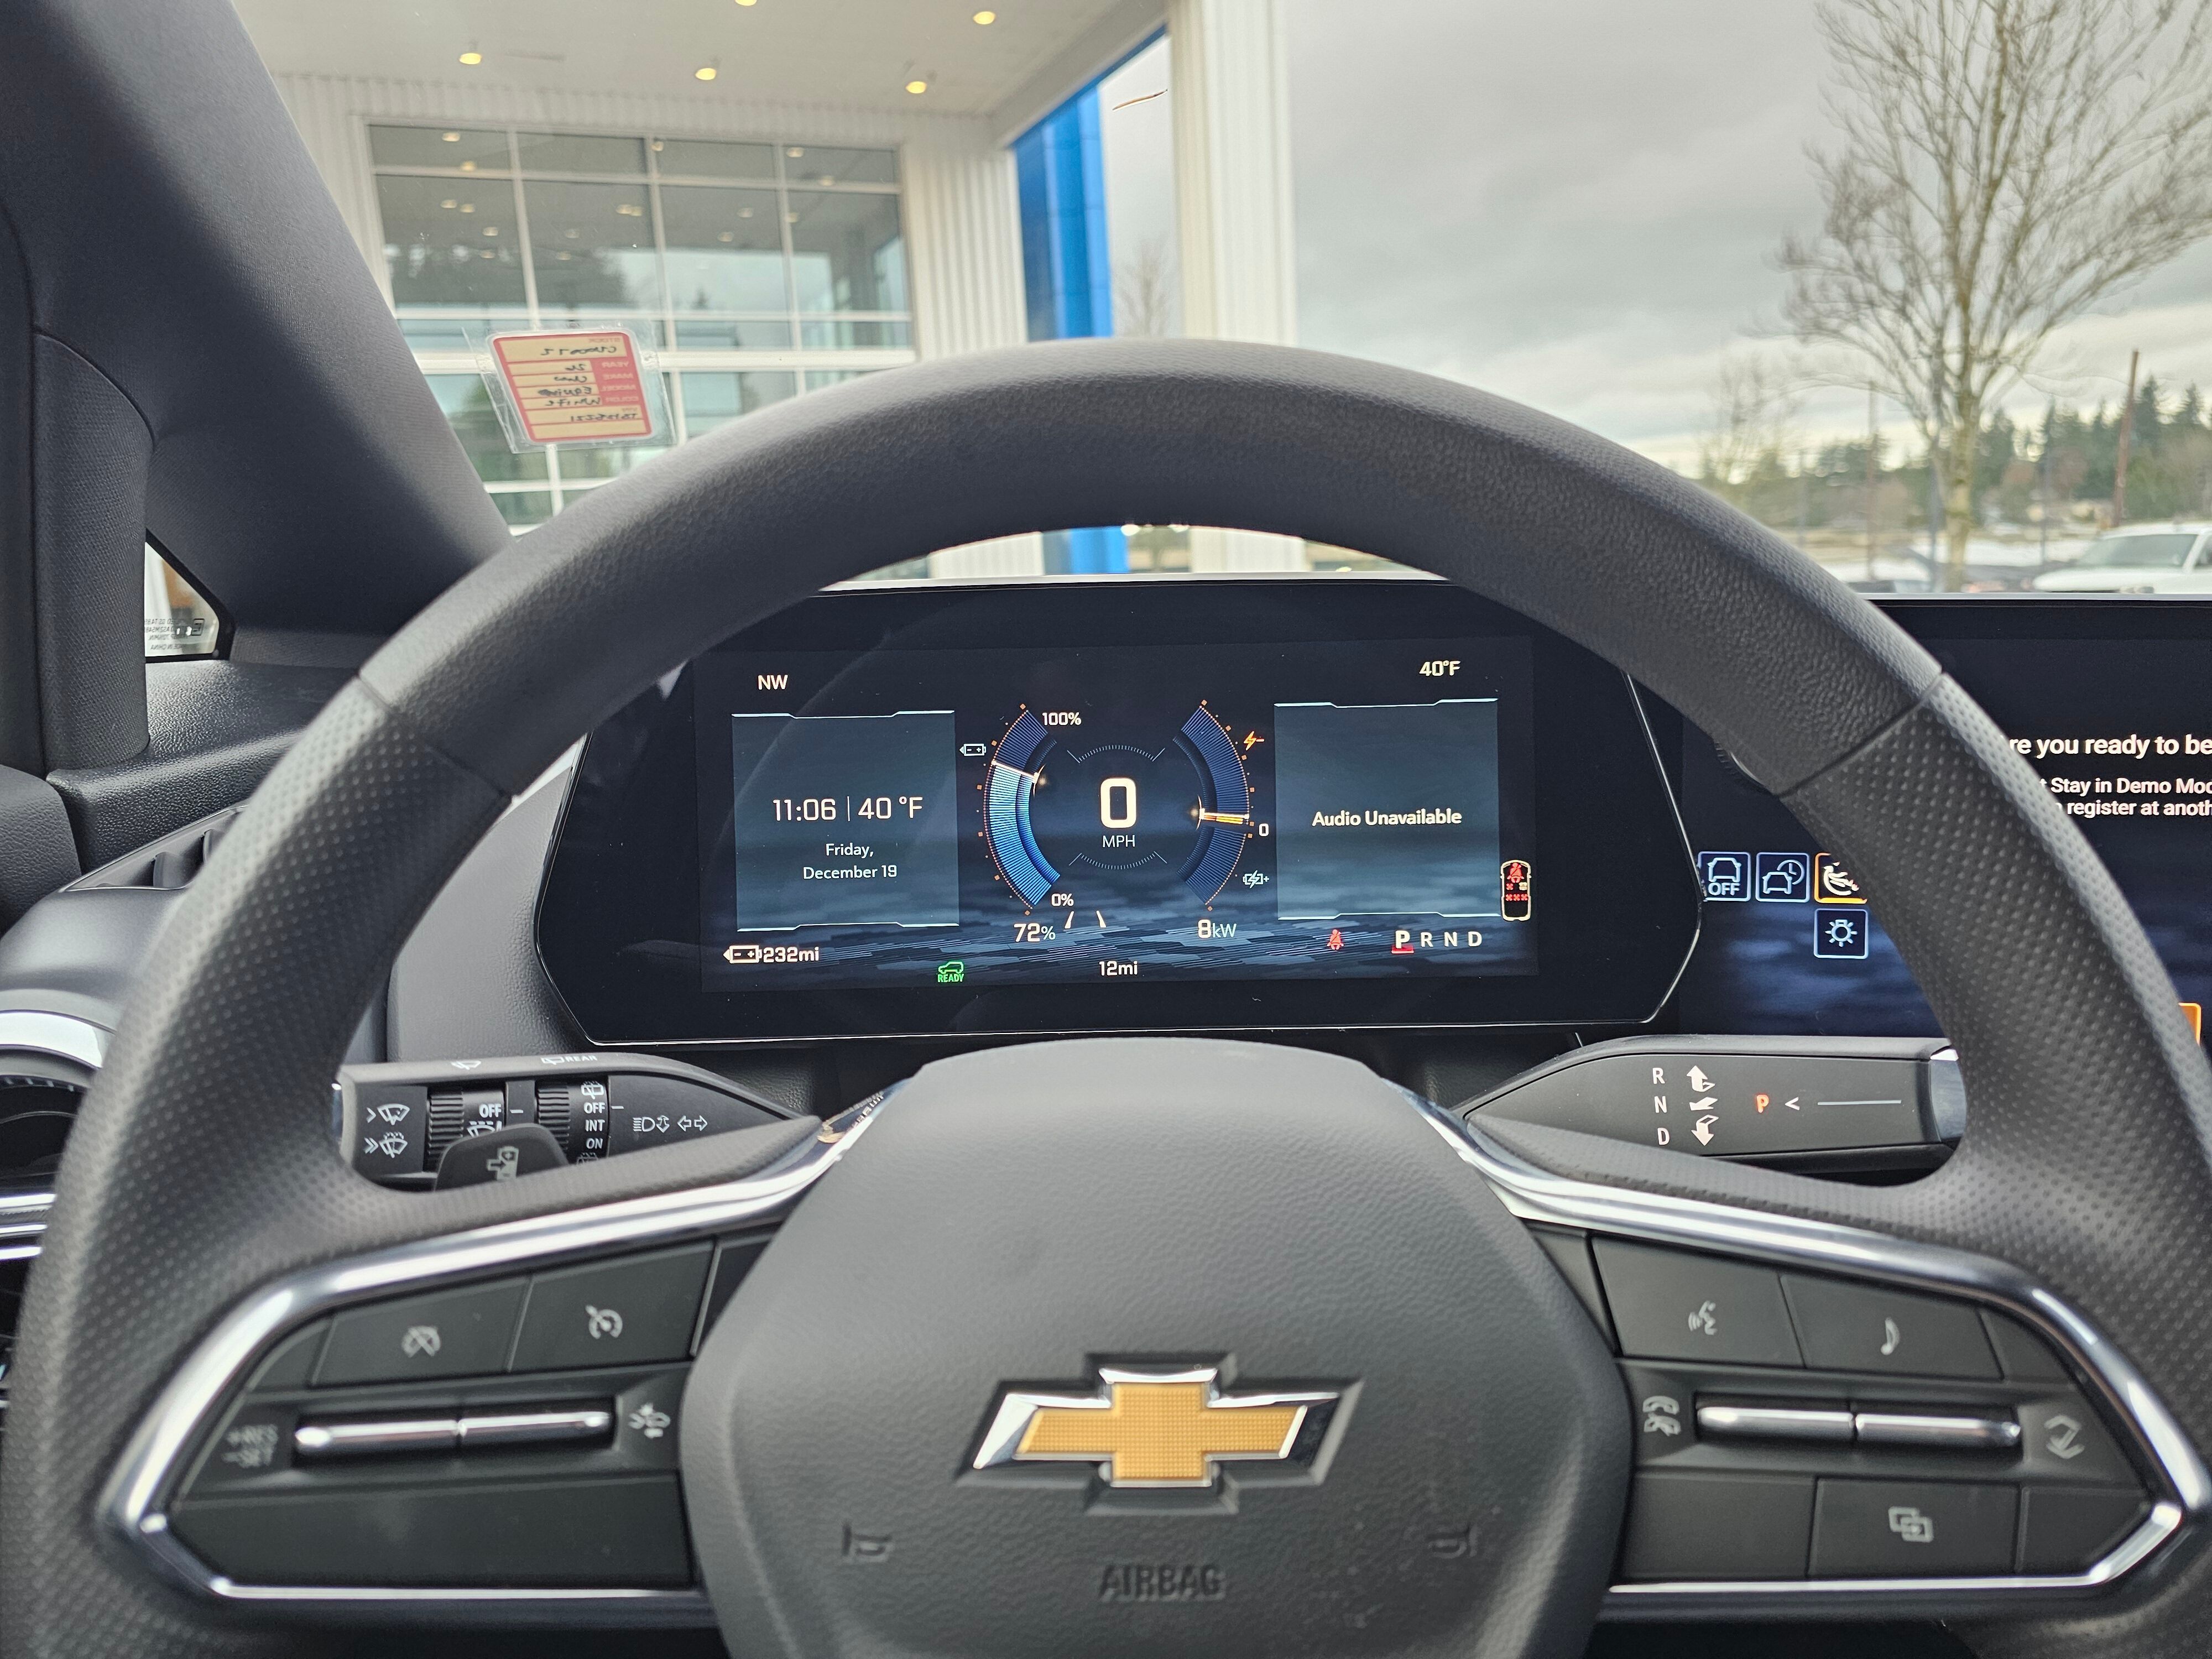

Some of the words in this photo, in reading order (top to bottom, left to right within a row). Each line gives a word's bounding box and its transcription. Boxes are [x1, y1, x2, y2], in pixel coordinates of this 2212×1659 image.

[1420, 660, 1460, 676] 40°F
[758, 675, 788, 690] NW
[1042, 712, 1082, 726] 100%
[2007, 737, 2032, 754] re
[2036, 738, 2079, 759] you
[2085, 734, 2151, 759] ready
[2154, 736, 2179, 754] to
[2051, 777, 2091, 797] Stay
[2095, 778, 2112, 793] in
[2116, 778, 2172, 794] Demo
[773, 798, 836, 821] 11:06
[858, 797, 891, 820] 40
[899, 796, 923, 818] °F
[1100, 778, 1136, 828] 0
[2067, 800, 2136, 818] register
[2140, 801, 2159, 816] at
[1312, 811, 1361, 827] Audio
[1365, 808, 1462, 826] Unavailable
[1259, 823, 1269, 837] 0
[1102, 834, 1135, 848] MPH
[826, 842, 874, 859] Friday,
[803, 865, 878, 879] December
[881, 865, 898, 878] 19
[1708, 882, 1740, 896] OFF
[1051, 893, 1074, 906] 0%
[1014, 923, 1056, 942] 72%
[1198, 920, 1237, 939] 8kW
[1395, 930, 1411, 948] P
[1420, 932, 1433, 947] R
[1444, 932, 1458, 947] N
[1468, 931, 1482, 947] D
[763, 946, 820, 963] 232mi
[1099, 961, 1138, 976] 12mi
[937, 973, 965, 983] READY
[1653, 1067, 1666, 1084] R
[479, 1103, 502, 1118] OFF
[584, 1102, 606, 1114] OFF
[1654, 1095, 1667, 1113] N
[1756, 1094, 1769, 1113] P
[585, 1119, 606, 1132] INT
[586, 1138, 603, 1149] ON
[1657, 1128, 1670, 1145] D
[1099, 1563, 1224, 1599] AIRBAG
